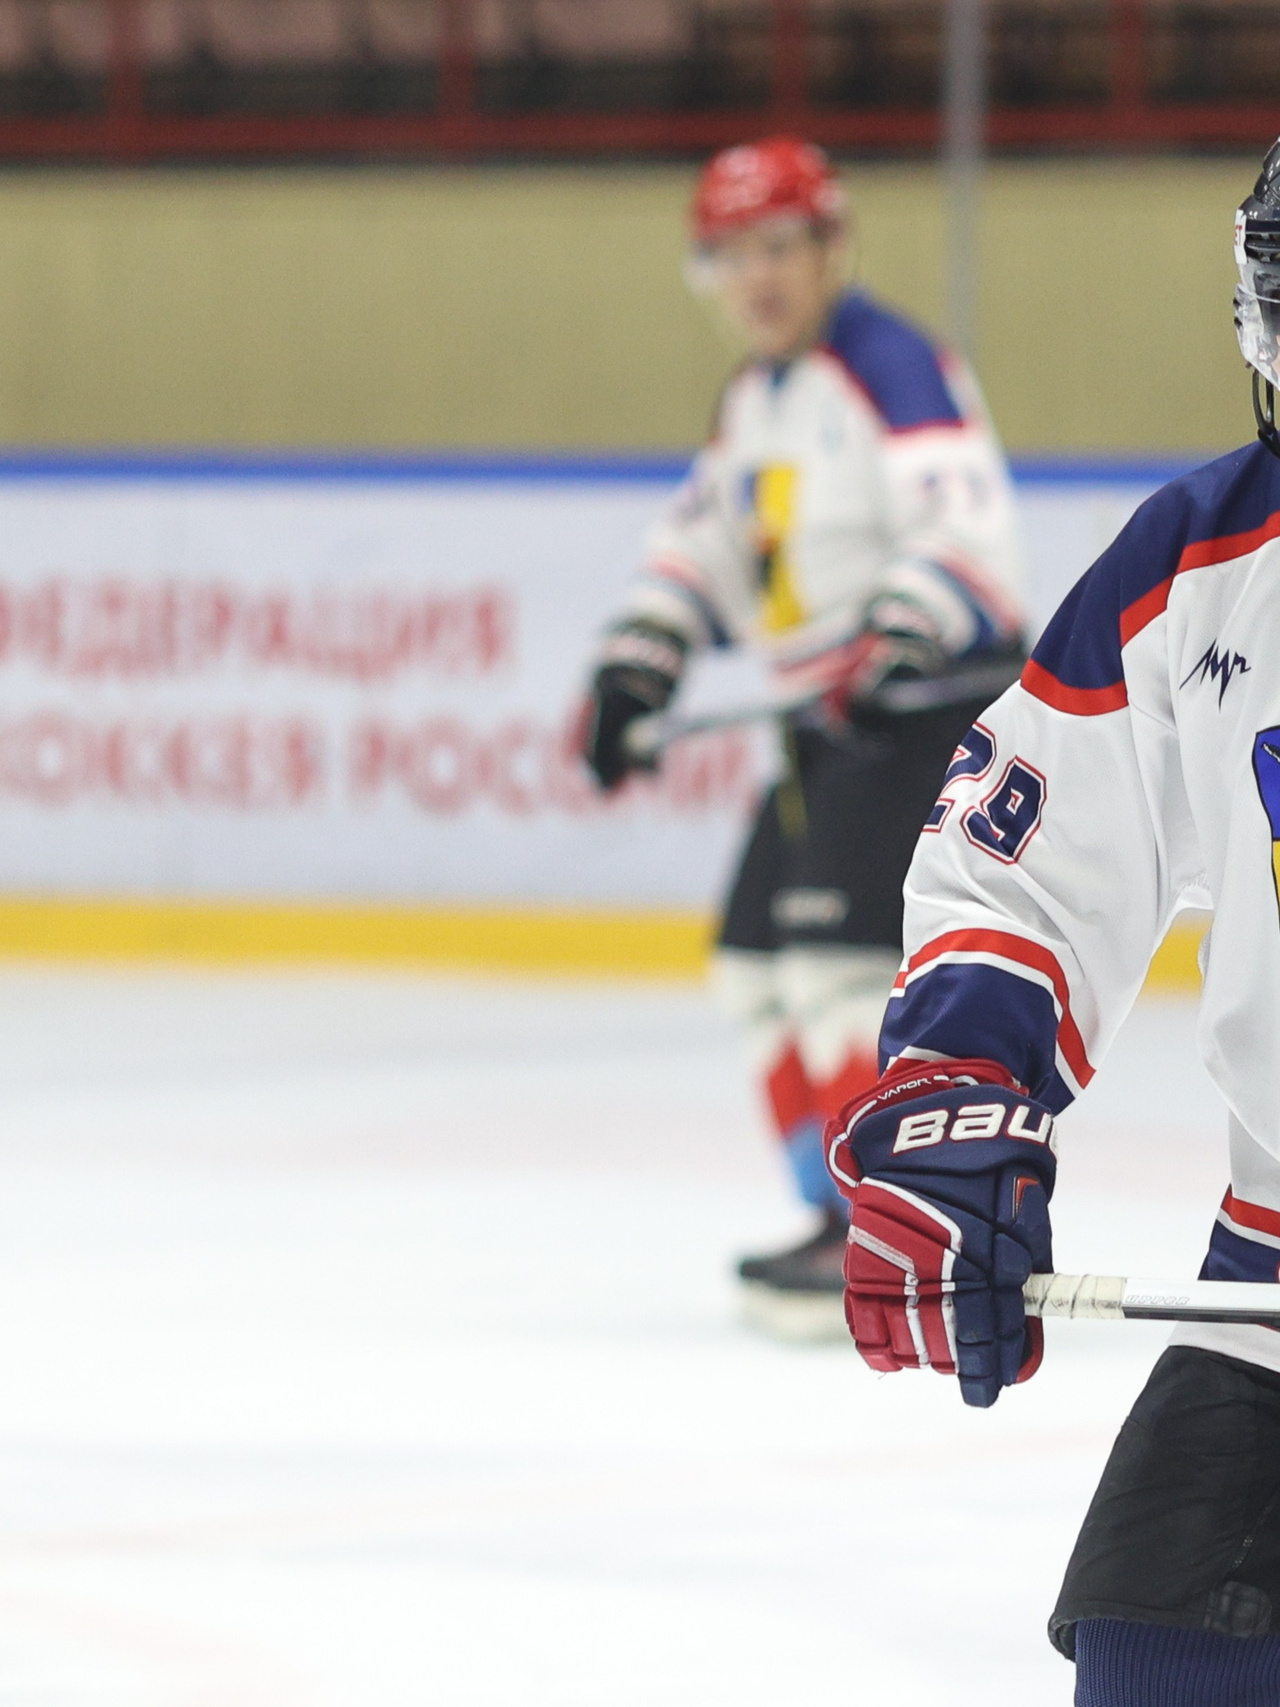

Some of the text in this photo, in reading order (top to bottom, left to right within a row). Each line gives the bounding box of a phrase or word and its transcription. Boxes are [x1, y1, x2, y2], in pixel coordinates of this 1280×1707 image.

[0, 582, 511, 686] ЕДЕРАЦИЯ
[0, 714, 322, 810] ОККЕЯ
[921, 720, 1047, 866] 29
[893, 1103, 1057, 1154] BAU
